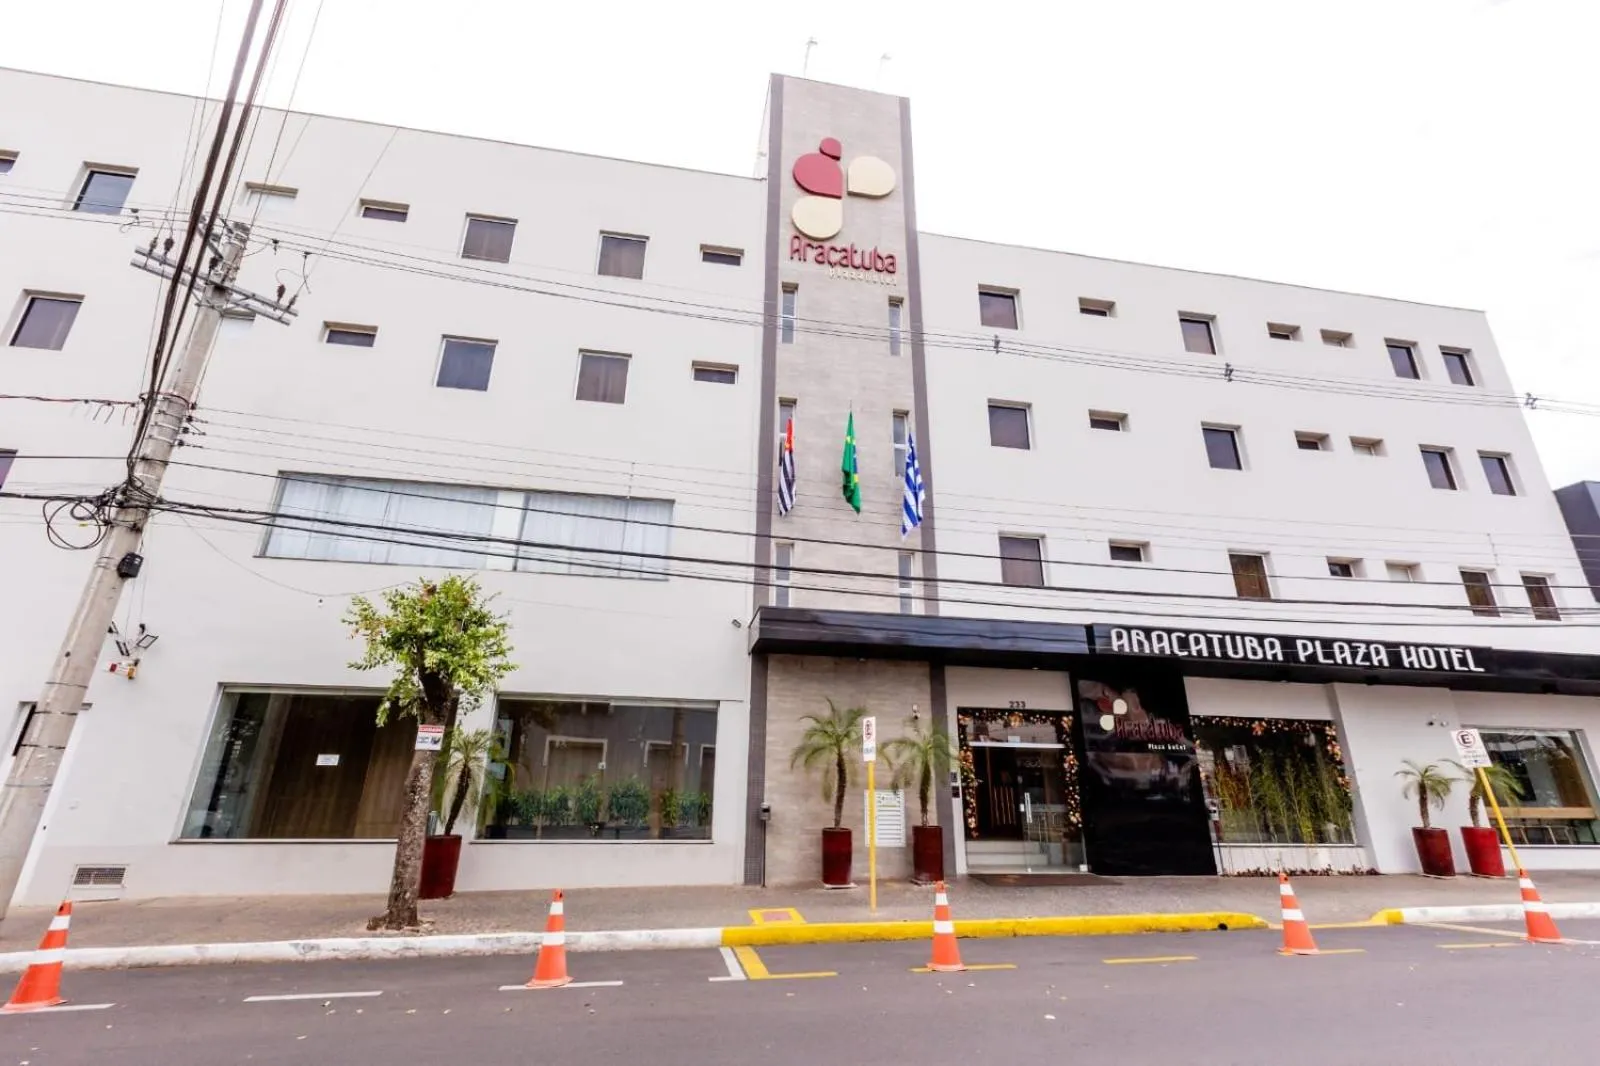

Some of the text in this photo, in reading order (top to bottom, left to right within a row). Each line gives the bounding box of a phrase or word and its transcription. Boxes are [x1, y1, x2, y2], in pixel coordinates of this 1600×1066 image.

[790, 235, 897, 274] Araçatuba
[1295, 639, 1390, 667] PLAZA
[1400, 645, 1486, 672] HOTEL
